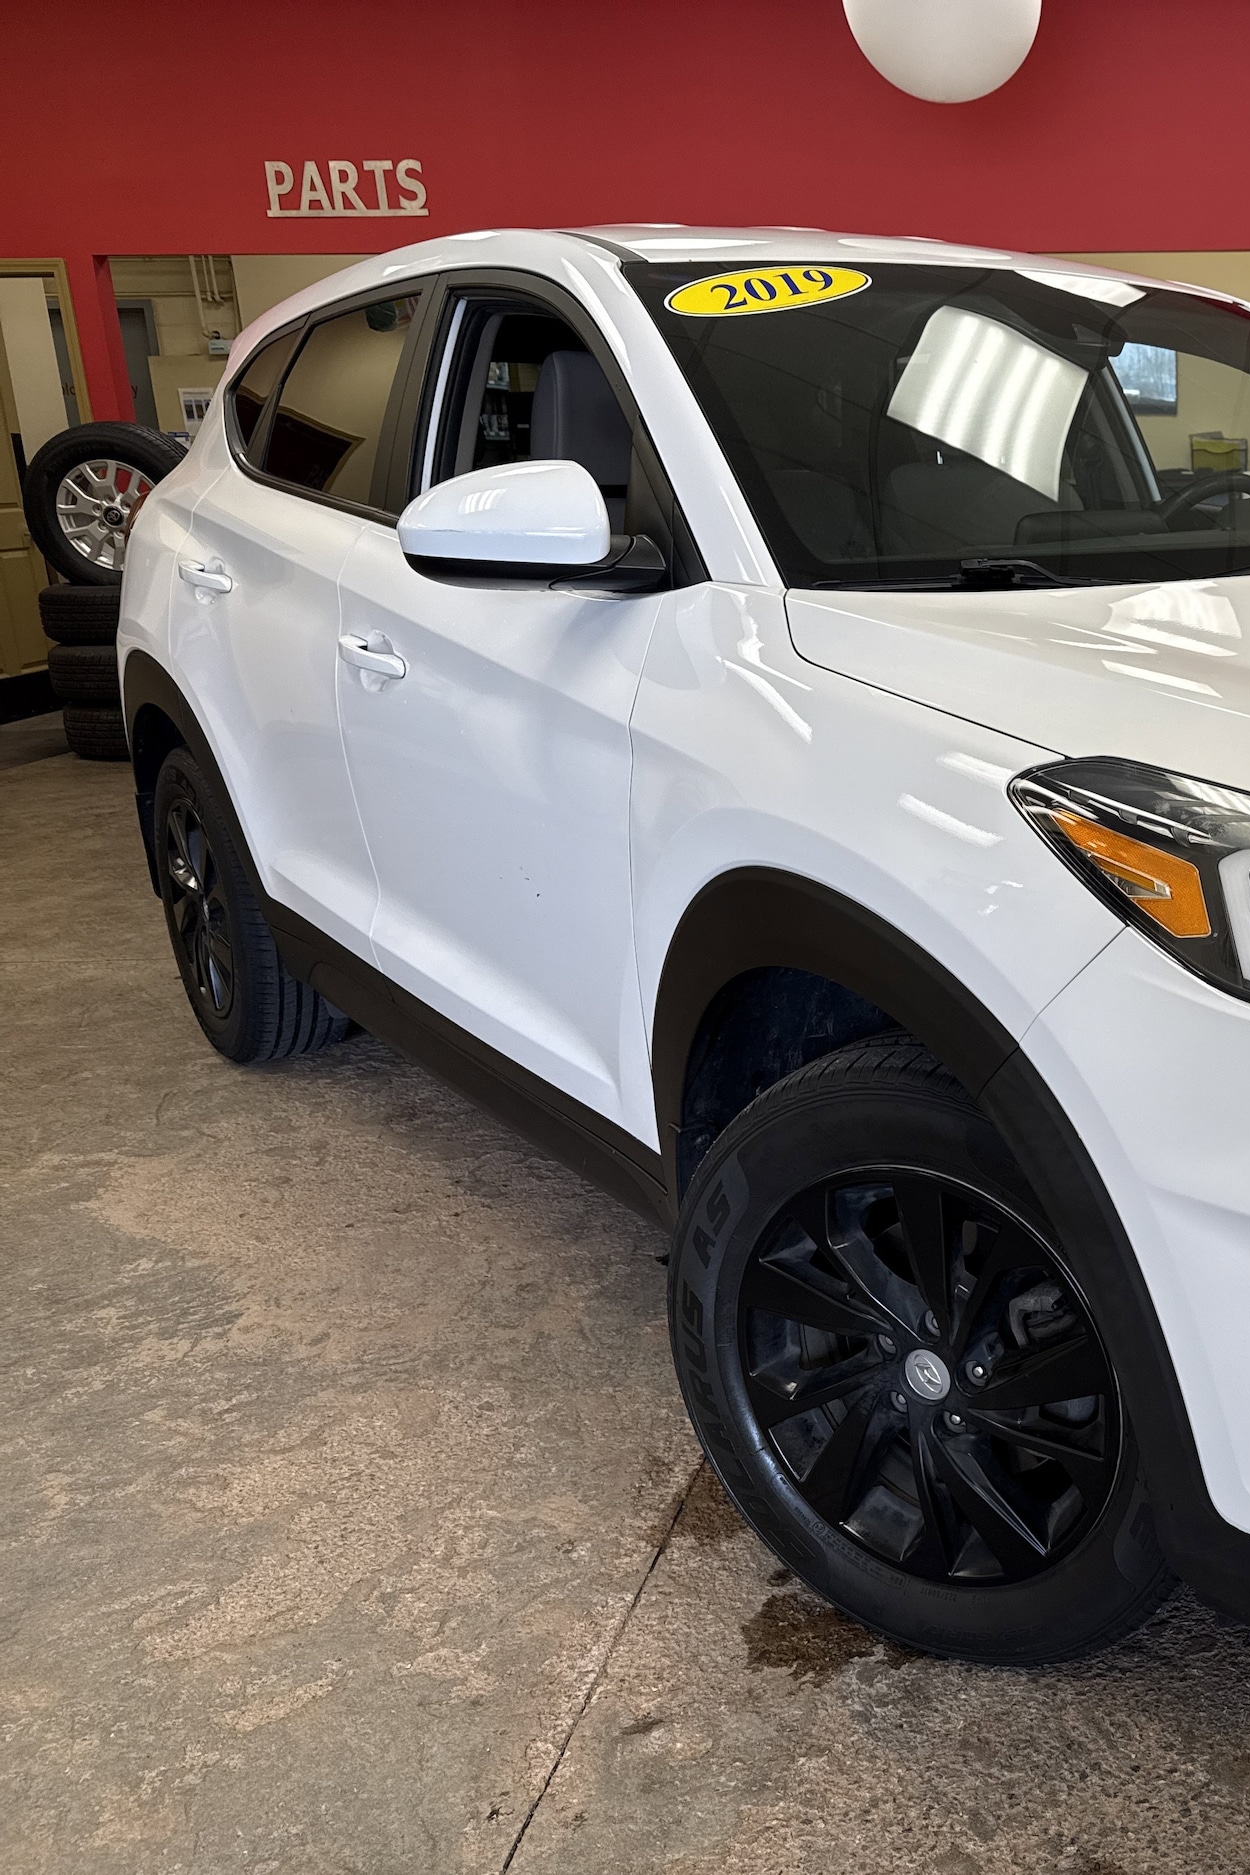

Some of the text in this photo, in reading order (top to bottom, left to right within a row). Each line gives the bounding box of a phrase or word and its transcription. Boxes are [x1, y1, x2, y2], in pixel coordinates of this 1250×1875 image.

[264, 159, 429, 214] PARTS
[710, 269, 833, 310] 2019
[692, 1179, 731, 1270] AS
